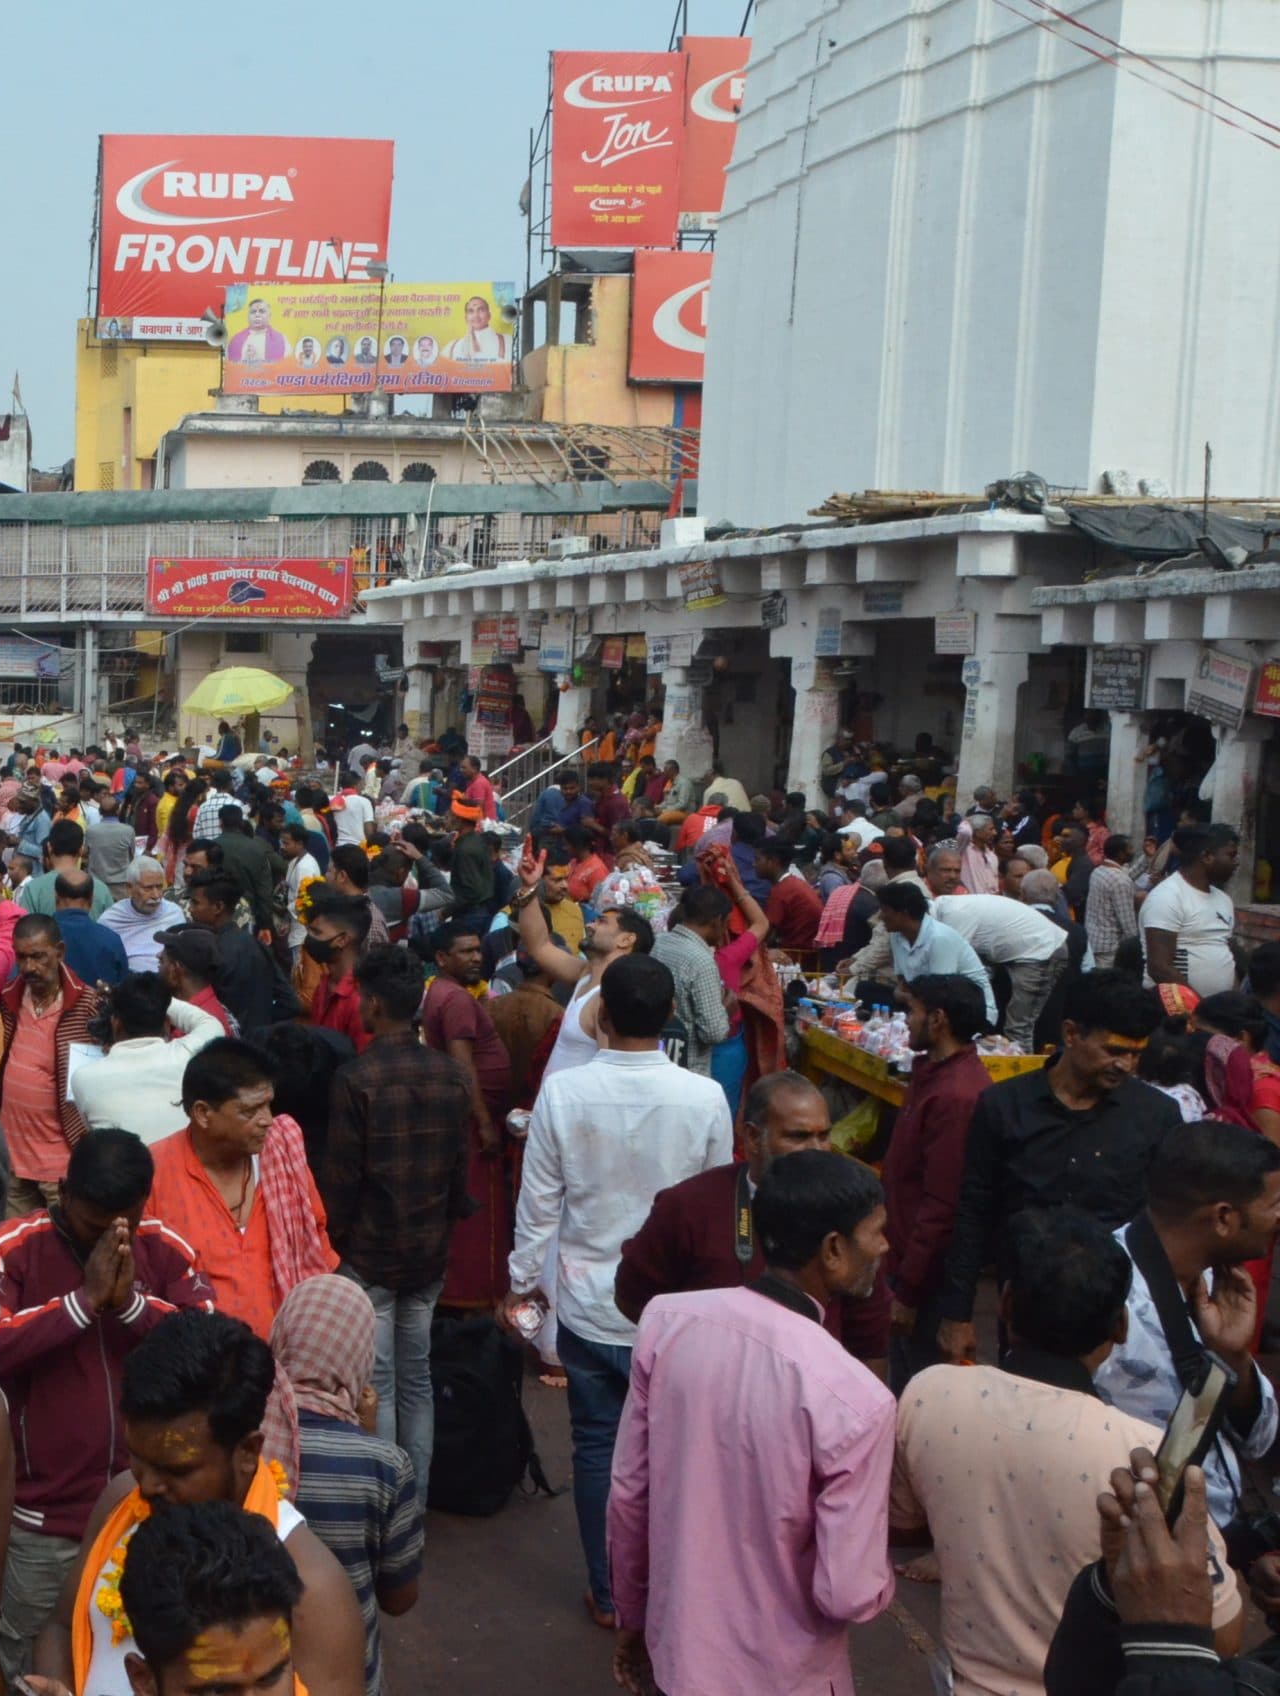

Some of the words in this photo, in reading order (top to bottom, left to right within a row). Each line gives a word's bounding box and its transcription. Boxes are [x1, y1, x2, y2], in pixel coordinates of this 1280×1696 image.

[591, 74, 673, 93] RUPA
[581, 113, 669, 164] Jon
[163, 171, 295, 202] RUPA
[114, 233, 379, 281] FRONTLINE
